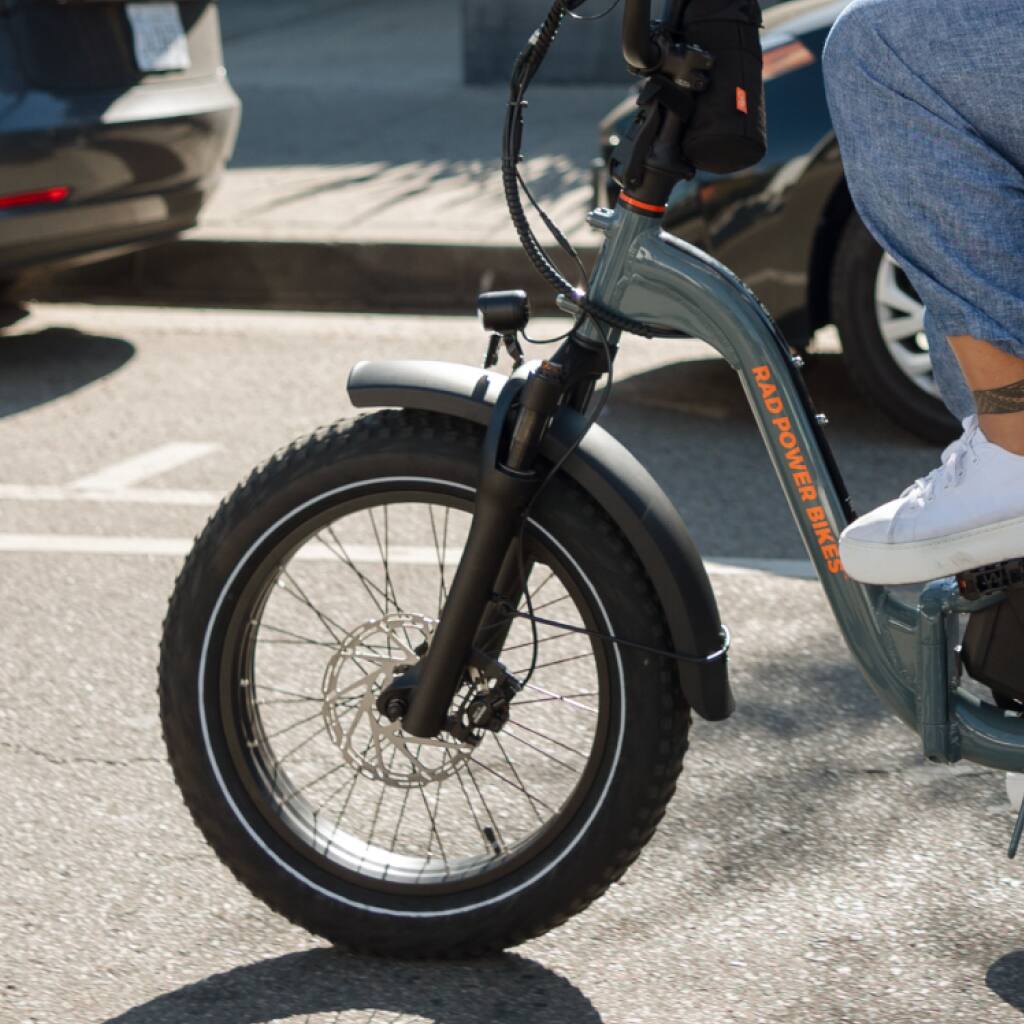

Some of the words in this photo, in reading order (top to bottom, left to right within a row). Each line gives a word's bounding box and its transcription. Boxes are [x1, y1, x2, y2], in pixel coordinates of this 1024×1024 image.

[752, 364, 785, 415] RAD
[772, 416, 818, 502] POWER
[805, 505, 842, 574] BIKES
